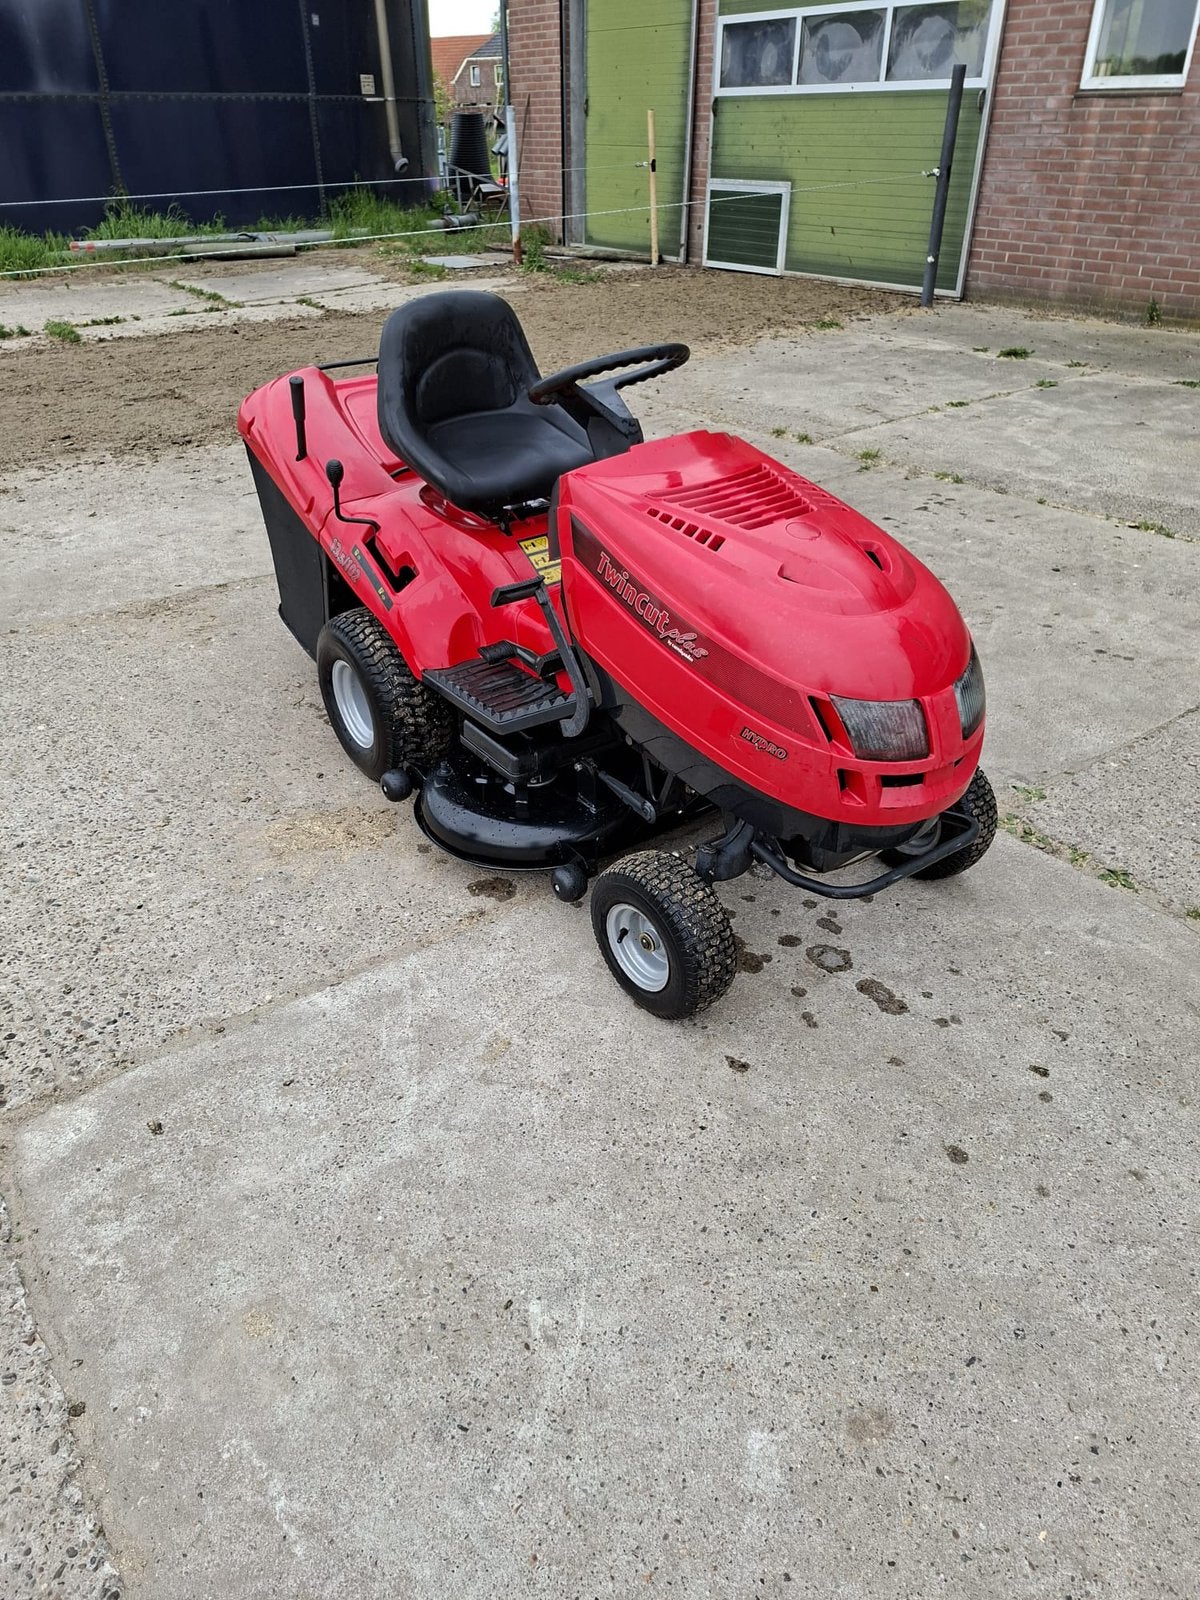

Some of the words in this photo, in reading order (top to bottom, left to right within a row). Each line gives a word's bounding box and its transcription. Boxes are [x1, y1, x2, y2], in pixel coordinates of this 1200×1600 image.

[596, 551, 670, 635] TwinCut
[659, 628, 709, 658] plus
[740, 726, 788, 761] HYDRO
